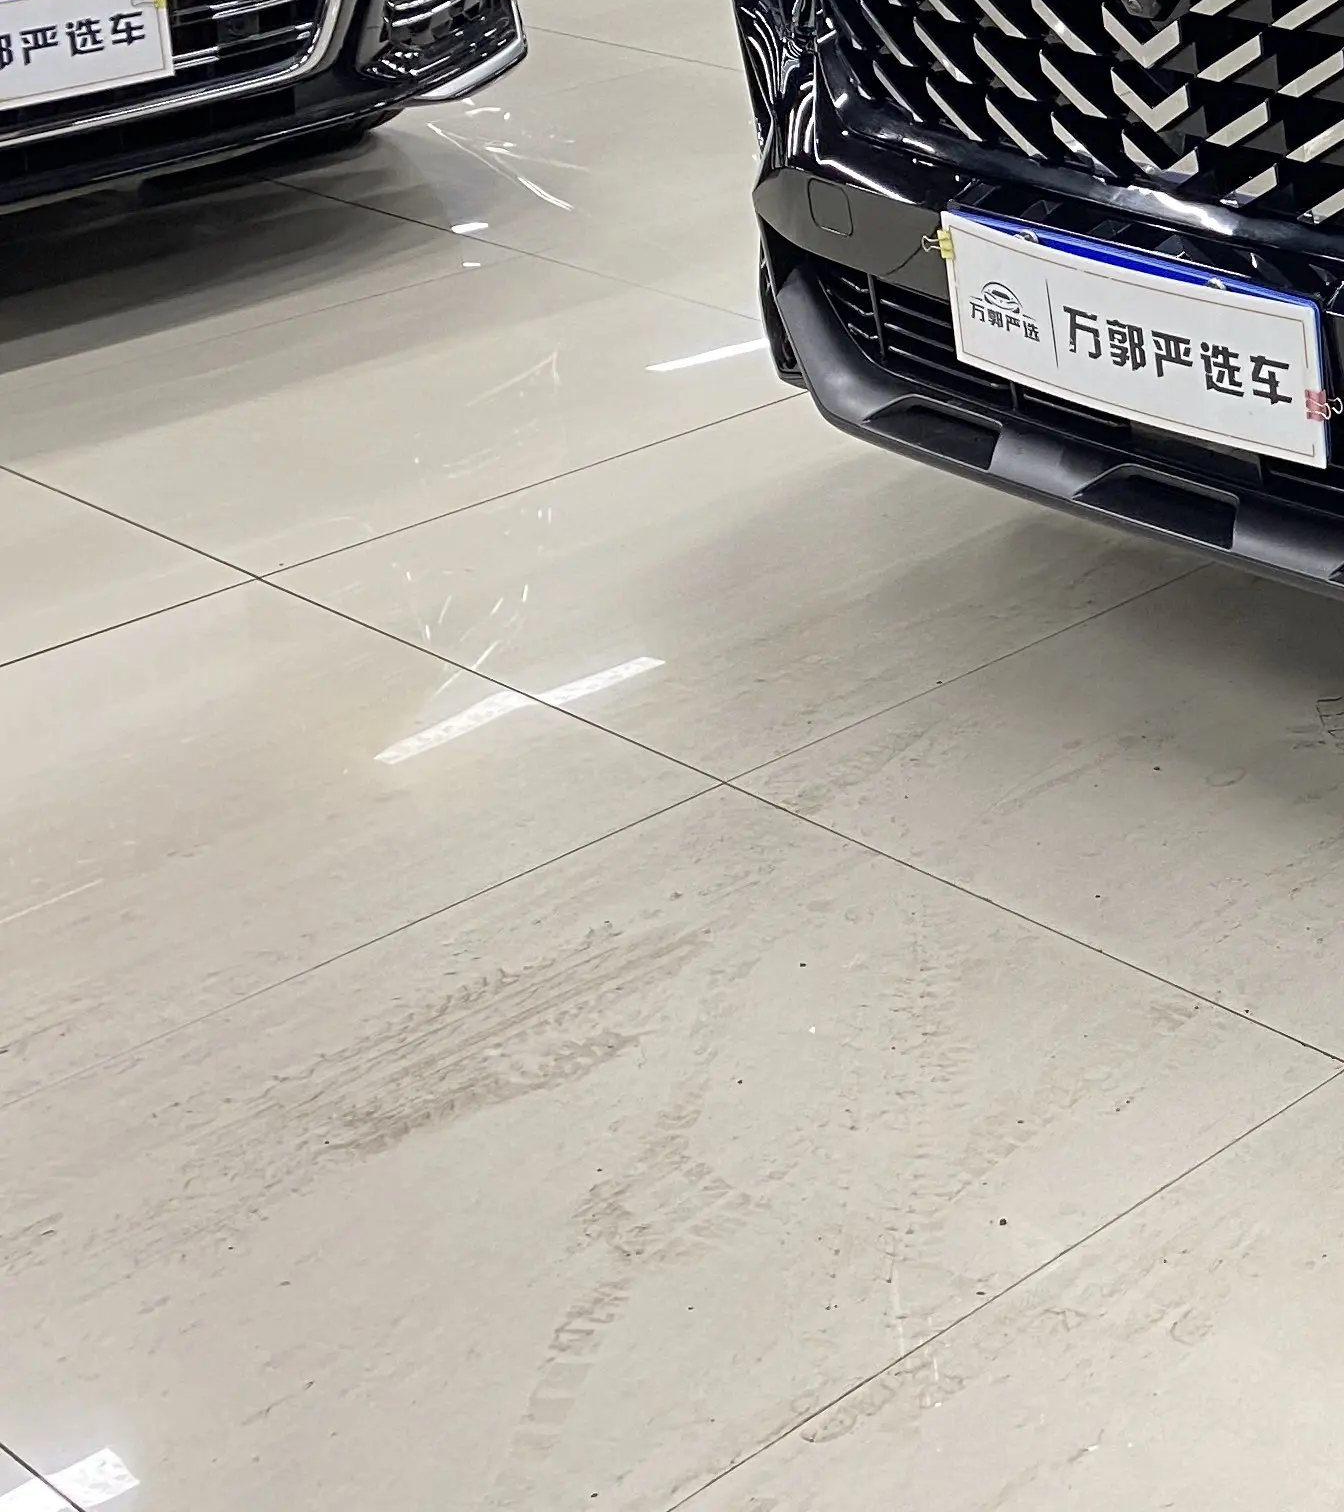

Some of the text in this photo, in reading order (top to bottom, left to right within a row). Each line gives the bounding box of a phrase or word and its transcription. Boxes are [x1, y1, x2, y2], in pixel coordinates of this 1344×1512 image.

[969, 302, 1040, 343] 万郭严选
[1062, 304, 1293, 406] 万郭严选车
